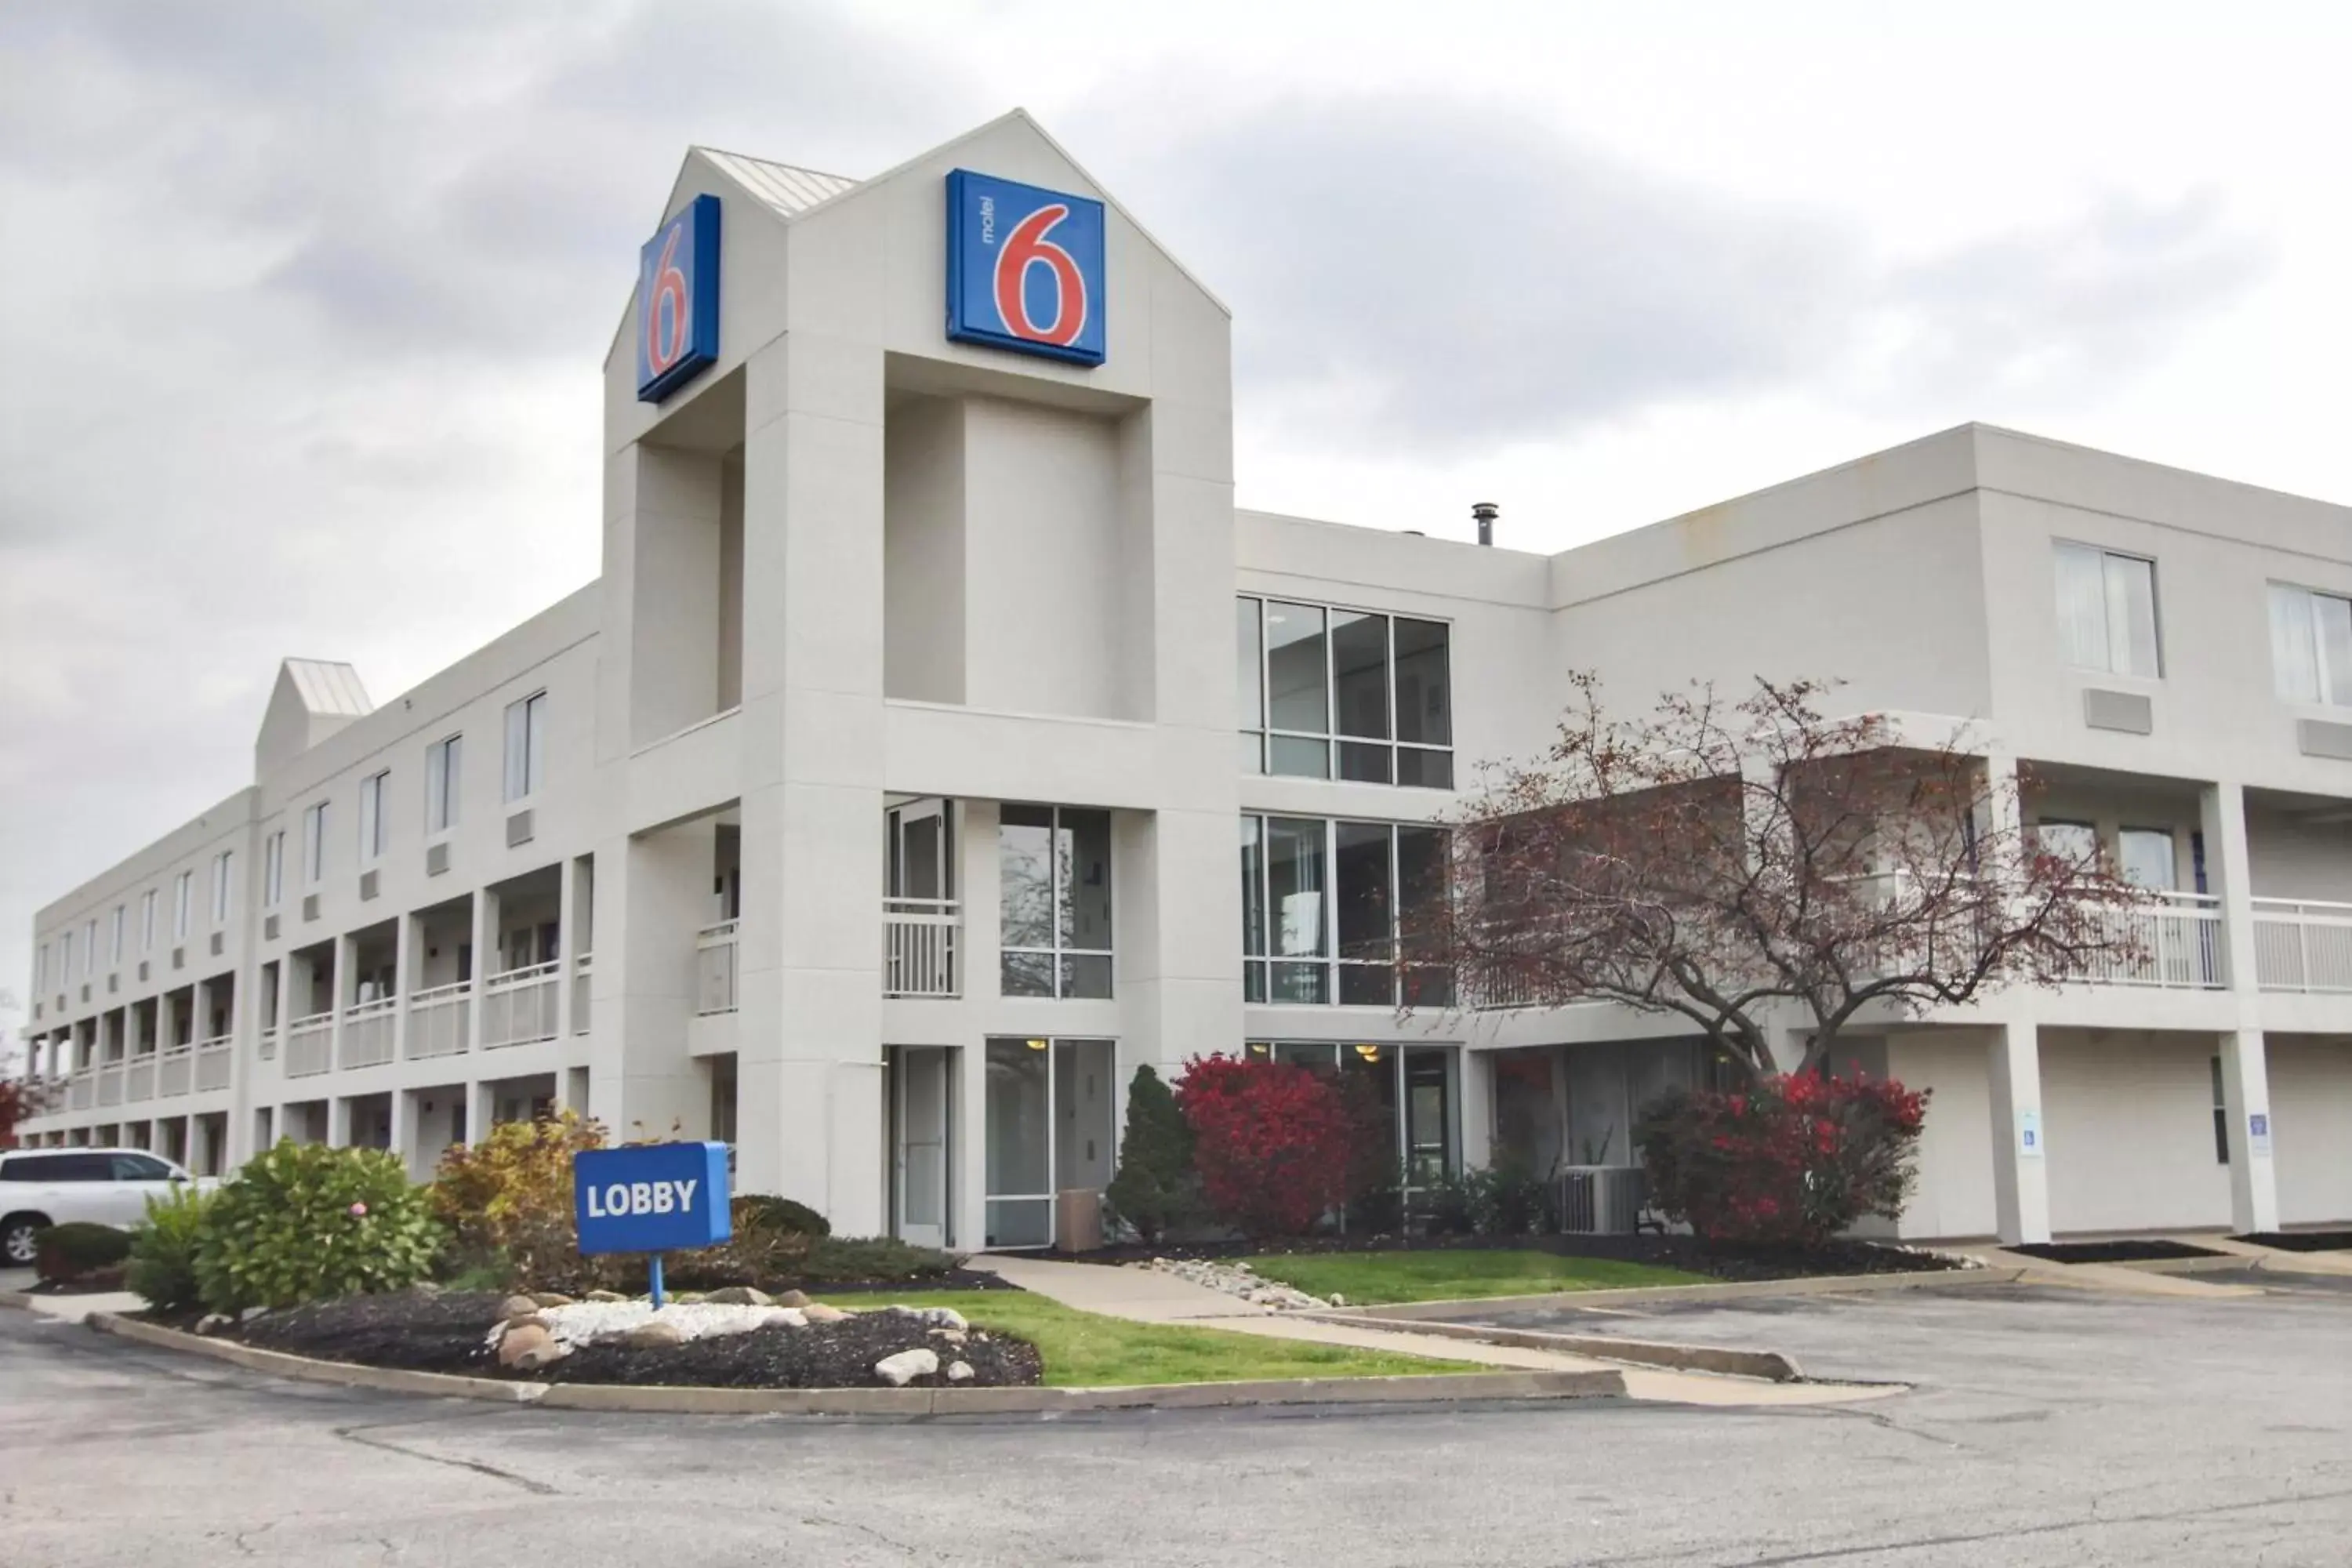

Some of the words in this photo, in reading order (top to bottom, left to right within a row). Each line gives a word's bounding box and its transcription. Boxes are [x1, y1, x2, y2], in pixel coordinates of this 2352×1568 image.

[979, 196, 994, 243] motel
[648, 223, 688, 376] 6
[993, 204, 1087, 346] 6
[588, 1179, 697, 1217] LOBBY
